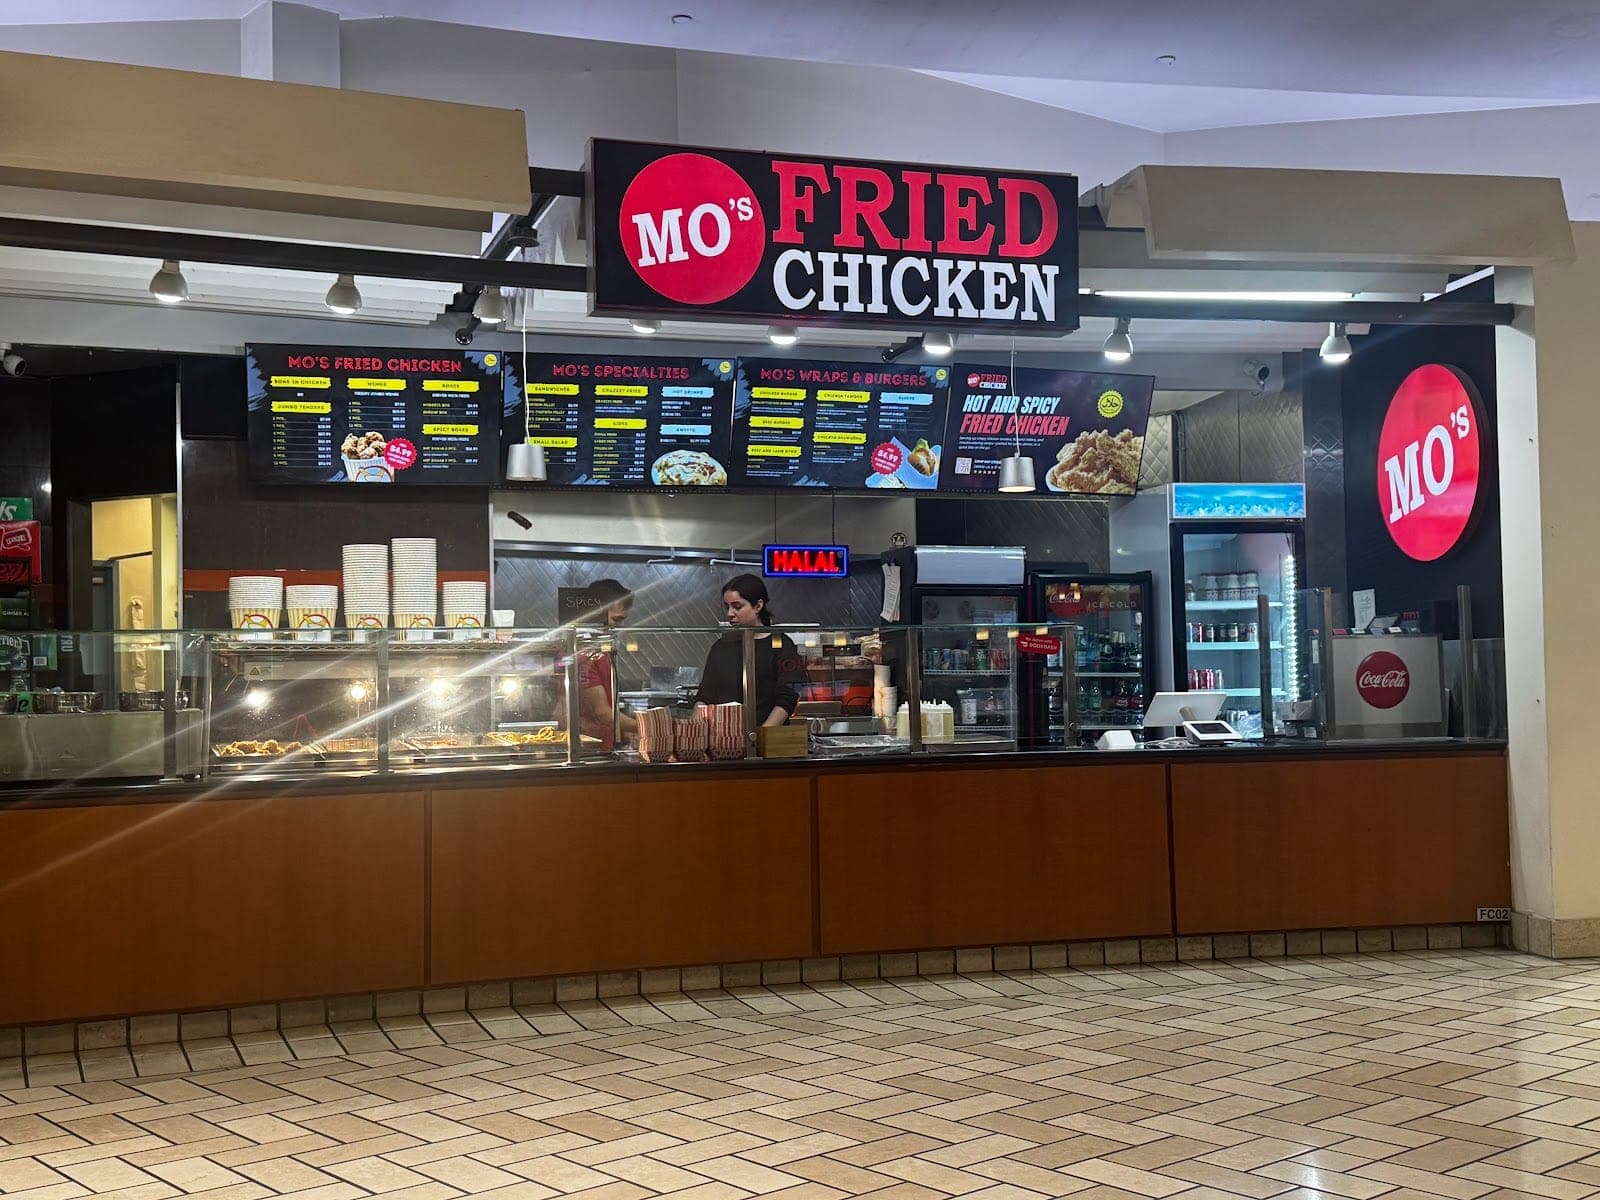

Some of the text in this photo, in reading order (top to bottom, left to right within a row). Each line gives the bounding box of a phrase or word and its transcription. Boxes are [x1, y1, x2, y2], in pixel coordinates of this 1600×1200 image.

[771, 159, 1060, 258] FRIED
[772, 248, 1060, 322] CHICKEN
[288, 355, 462, 373] MO'S FRIED CHICKEN
[552, 363, 689, 380] MO'S SPECIALTIES
[760, 368, 796, 382] MO'S
[799, 369, 849, 384] WRAPS
[865, 372, 928, 387] BURGERS
[980, 374, 1008, 382] FRIED
[962, 394, 1062, 414] HOT AND SPICY
[959, 413, 1071, 436] FRIED CHICKEN
[773, 550, 839, 573] HALAL
[566, 596, 601, 609] Spicy
[1088, 601, 1137, 610] ICE COLD
[1359, 670, 1408, 689] Coca-Cola
[1480, 909, 1509, 920] FC02
